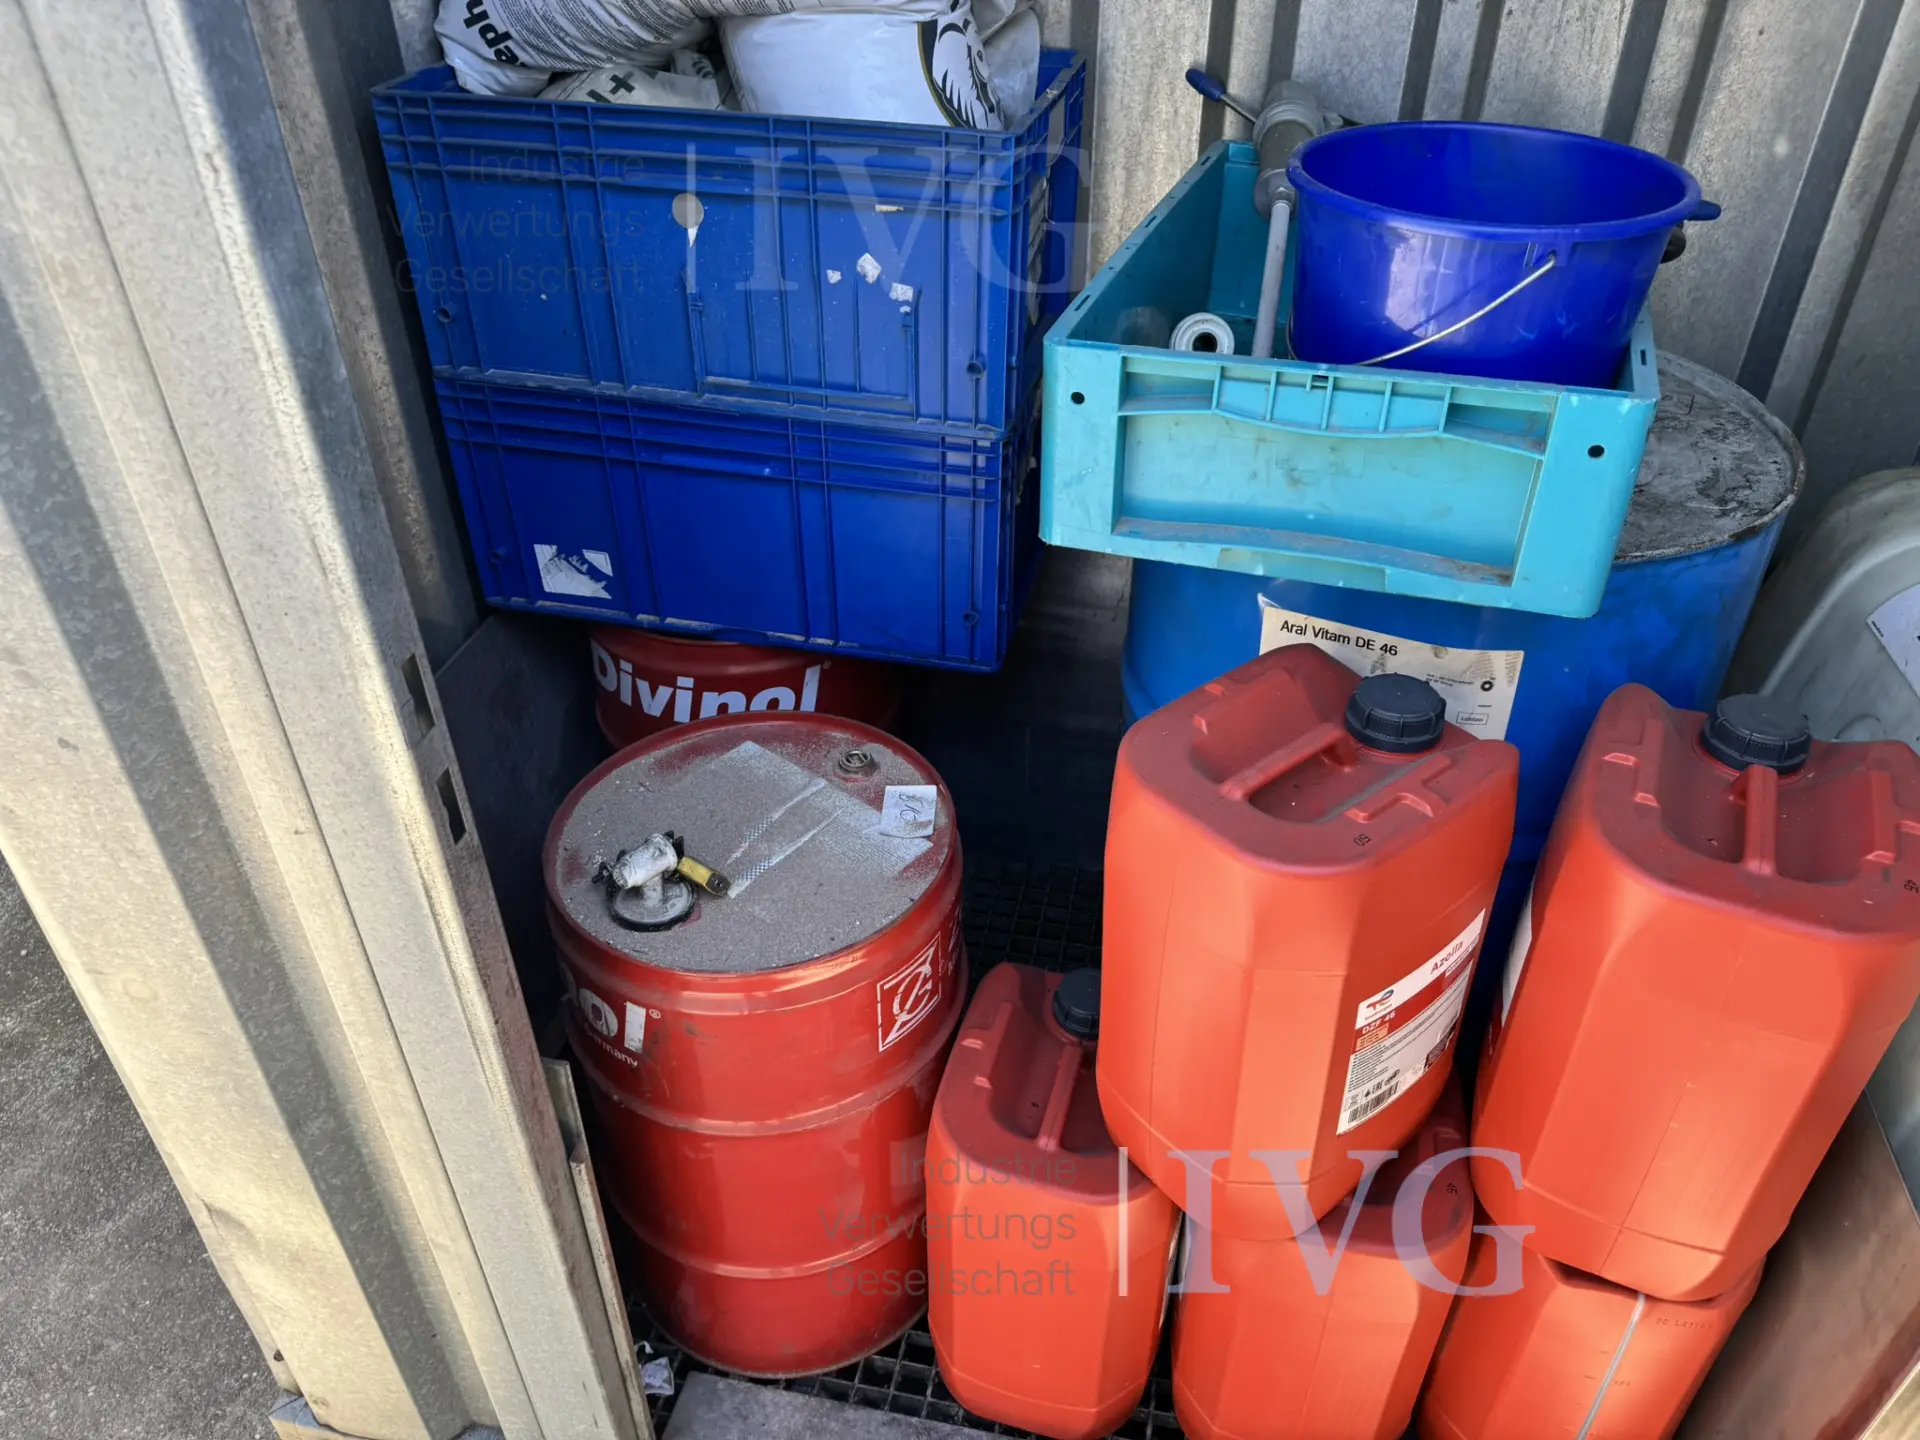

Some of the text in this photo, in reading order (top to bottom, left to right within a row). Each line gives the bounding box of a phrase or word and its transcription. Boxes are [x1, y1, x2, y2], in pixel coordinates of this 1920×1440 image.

[1280, 620, 1398, 656] Aral Vitam DE 46
